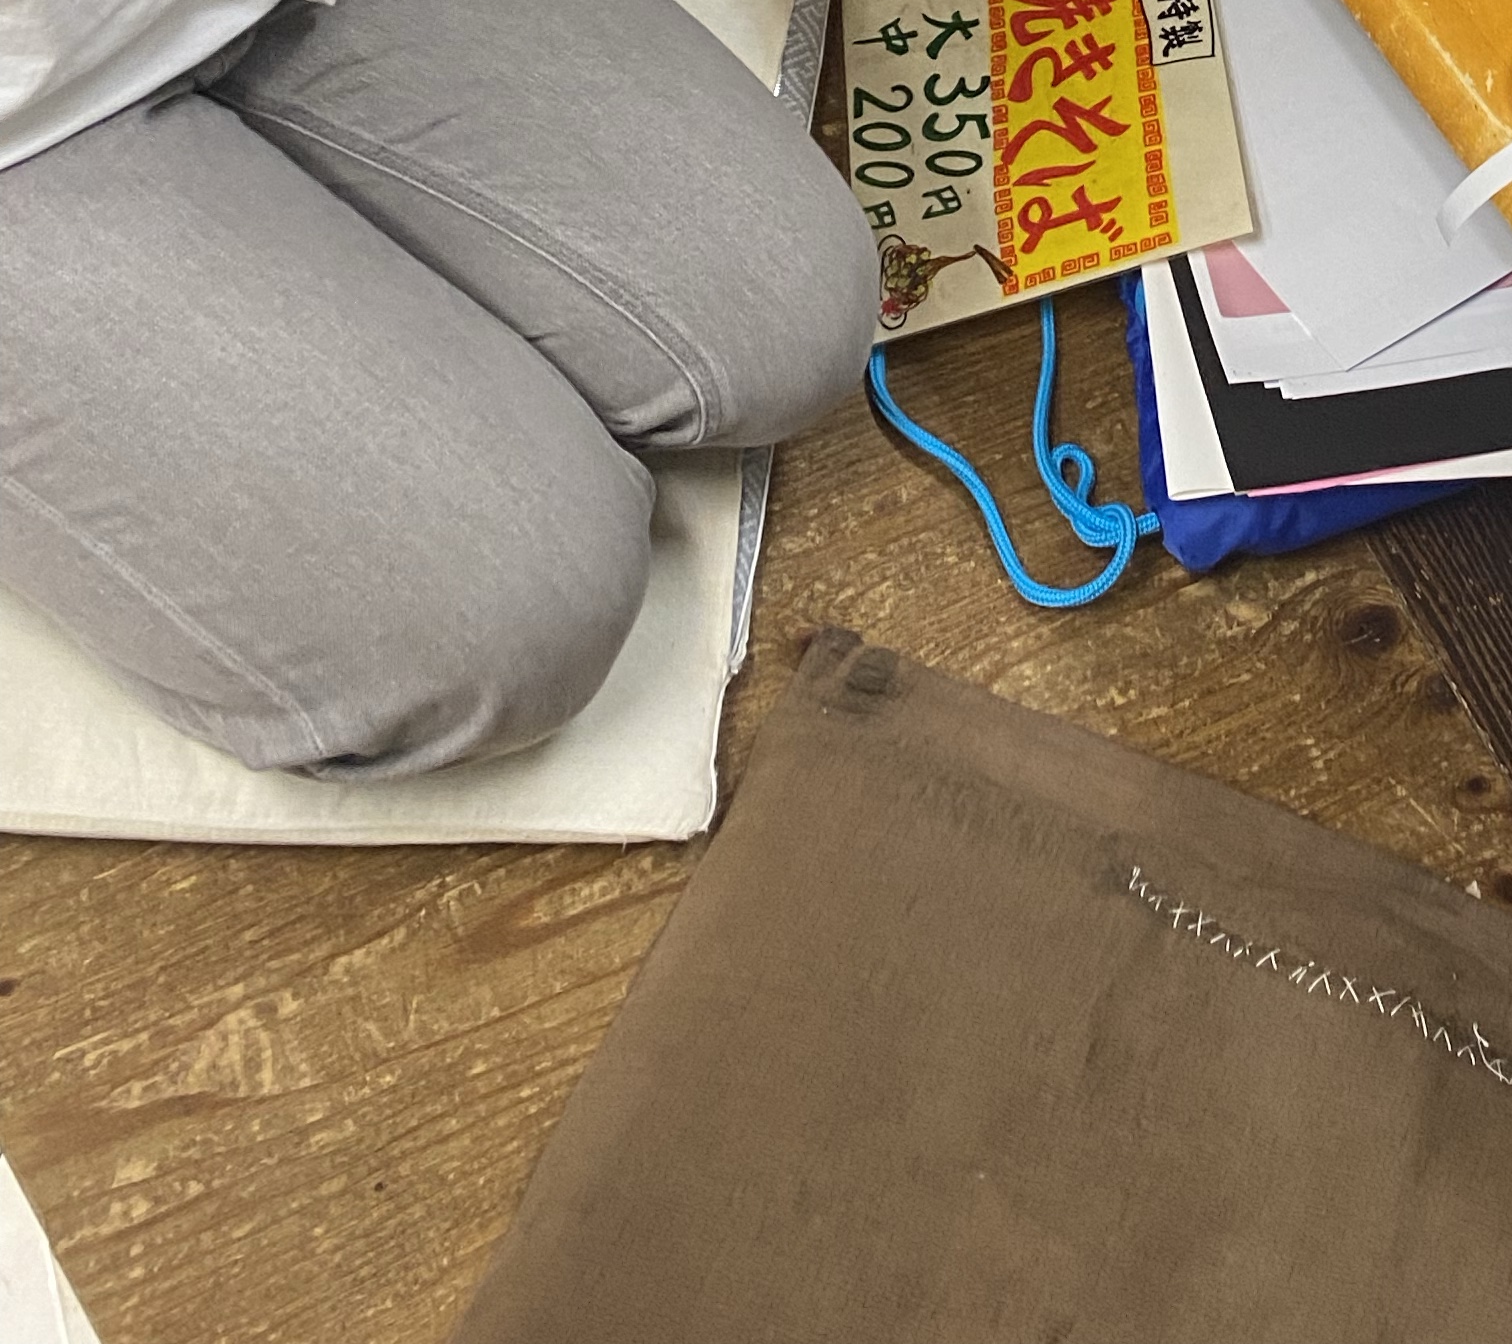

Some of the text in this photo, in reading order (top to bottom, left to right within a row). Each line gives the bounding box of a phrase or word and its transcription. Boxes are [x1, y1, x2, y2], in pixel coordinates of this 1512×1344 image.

[851, 17, 919, 231] 中 200円
[921, 9, 992, 221] 大 350円
